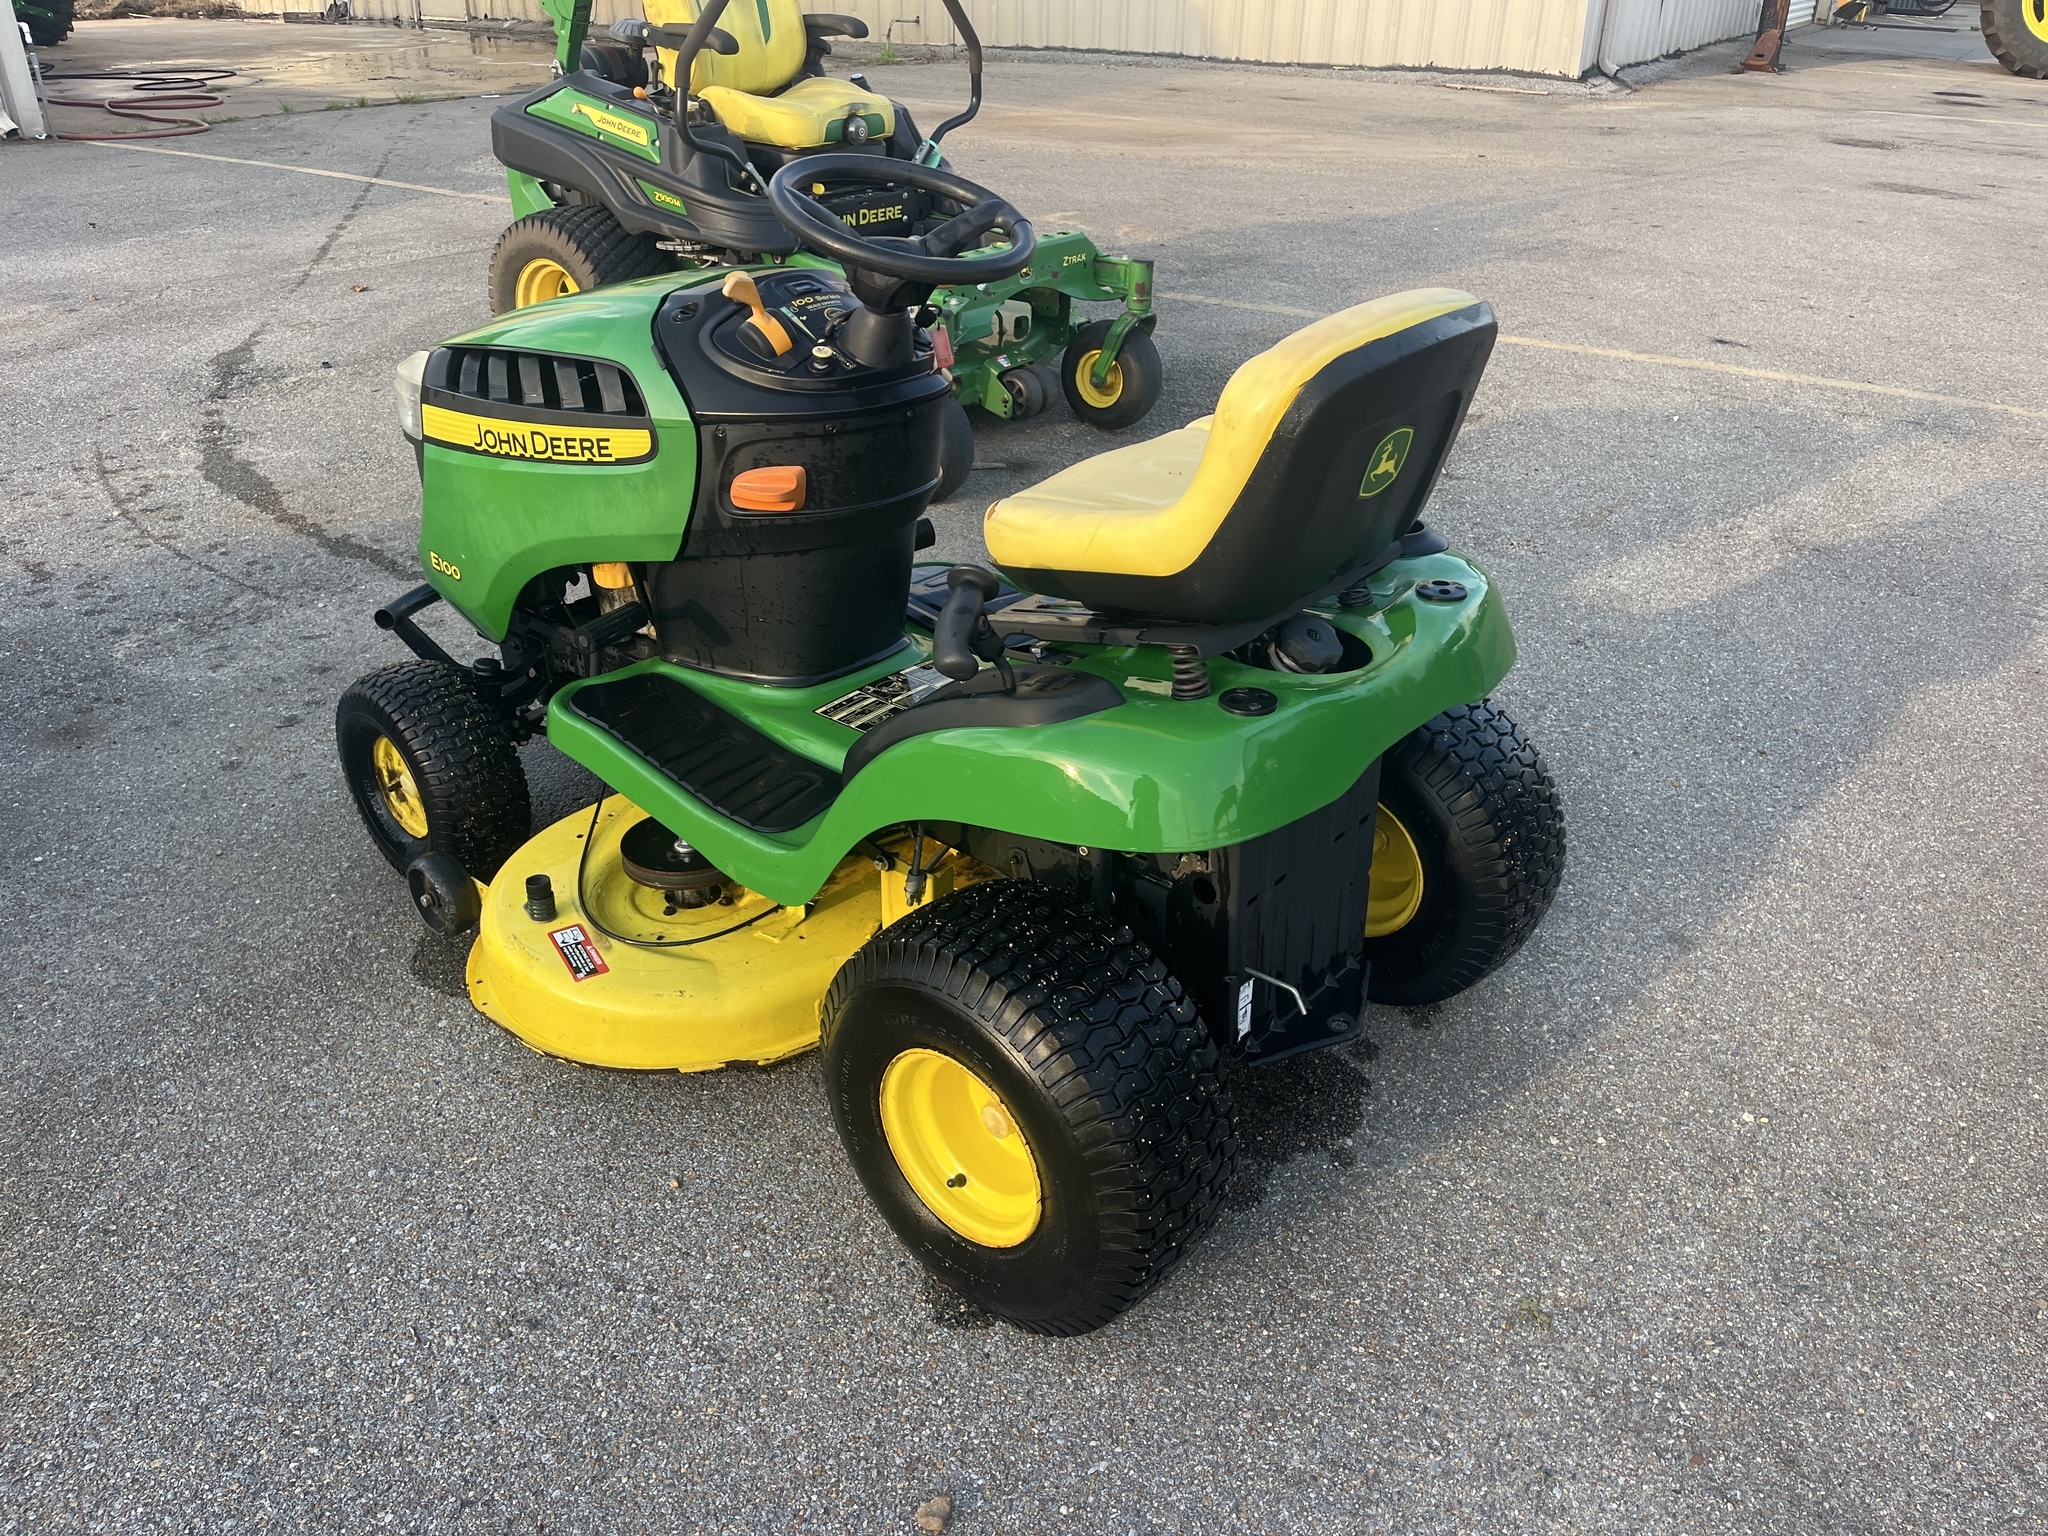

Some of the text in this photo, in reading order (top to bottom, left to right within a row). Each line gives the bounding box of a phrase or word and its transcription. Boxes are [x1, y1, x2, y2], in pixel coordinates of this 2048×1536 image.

[597, 115, 641, 138] JOHN DEERE
[859, 205, 903, 225] DEERE
[1062, 252, 1087, 267] ZTRAK
[791, 293, 841, 307] 100 Series
[474, 423, 613, 458] JOHN DEERE
[429, 550, 461, 580] E100
